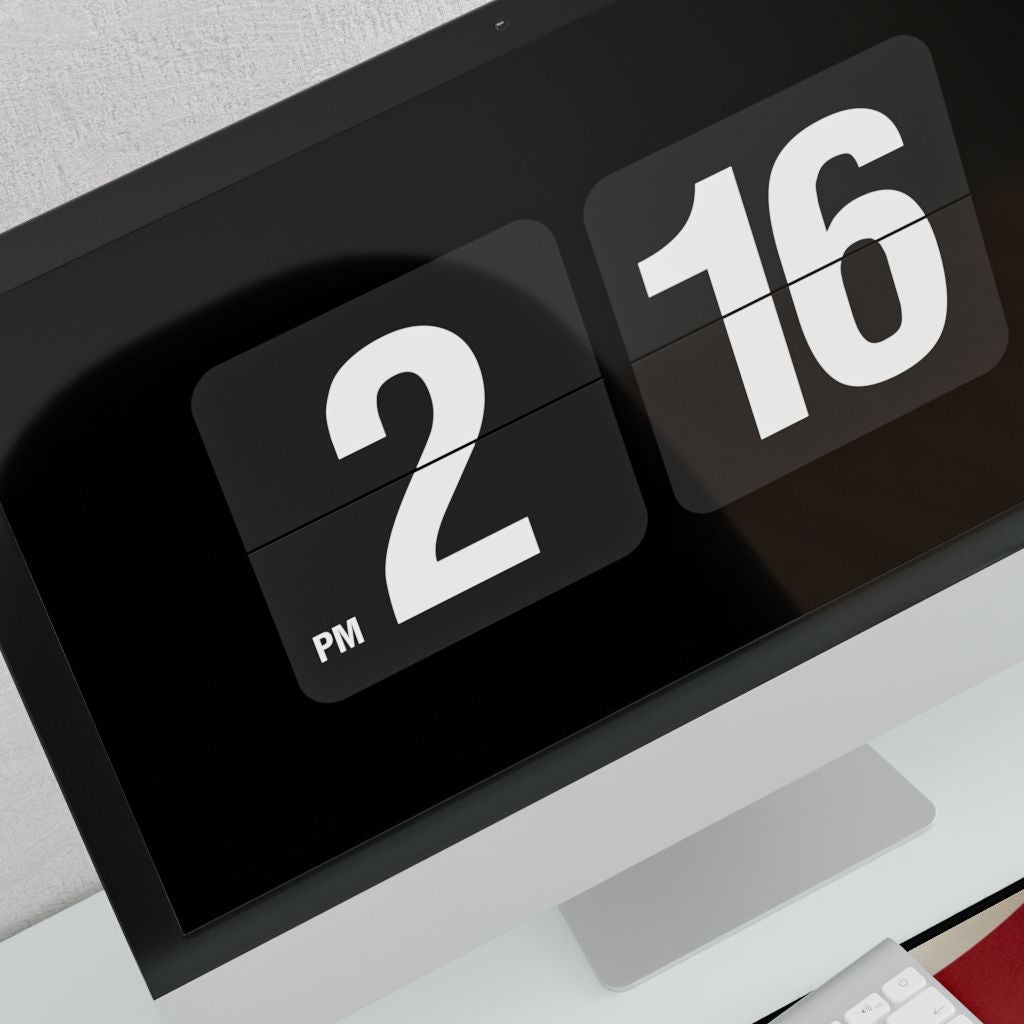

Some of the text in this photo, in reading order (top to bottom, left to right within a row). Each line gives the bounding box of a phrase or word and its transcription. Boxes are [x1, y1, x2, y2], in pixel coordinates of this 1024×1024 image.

[326, 108, 947, 624] 2 16
[312, 617, 364, 663] PM
